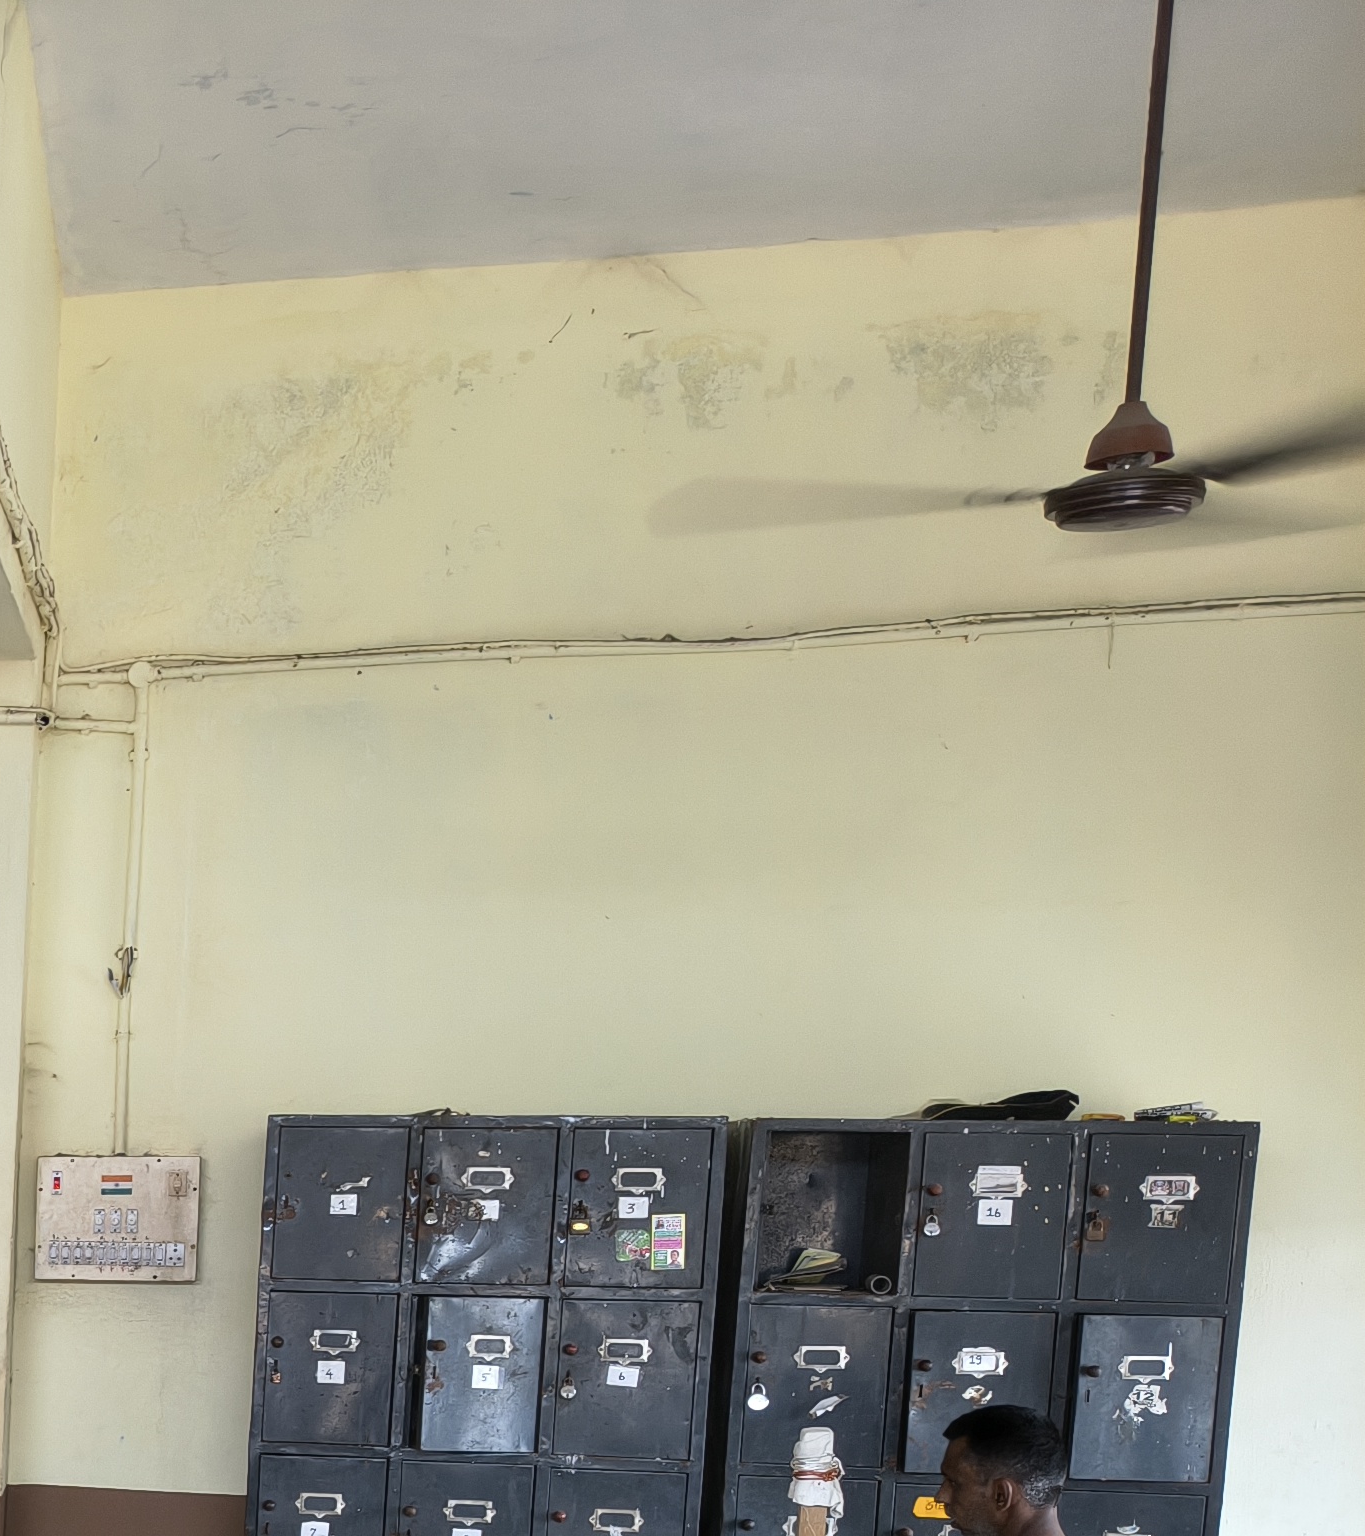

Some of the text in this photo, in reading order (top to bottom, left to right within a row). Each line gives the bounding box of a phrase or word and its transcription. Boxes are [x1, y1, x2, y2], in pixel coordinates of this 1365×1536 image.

[338, 1199, 348, 1211] 1
[625, 1203, 636, 1215] 3
[985, 1206, 1002, 1218] 16
[968, 1354, 982, 1366] 19
[325, 1368, 334, 1381] 4
[481, 1372, 491, 1382] 5
[618, 1371, 626, 1381] 6
